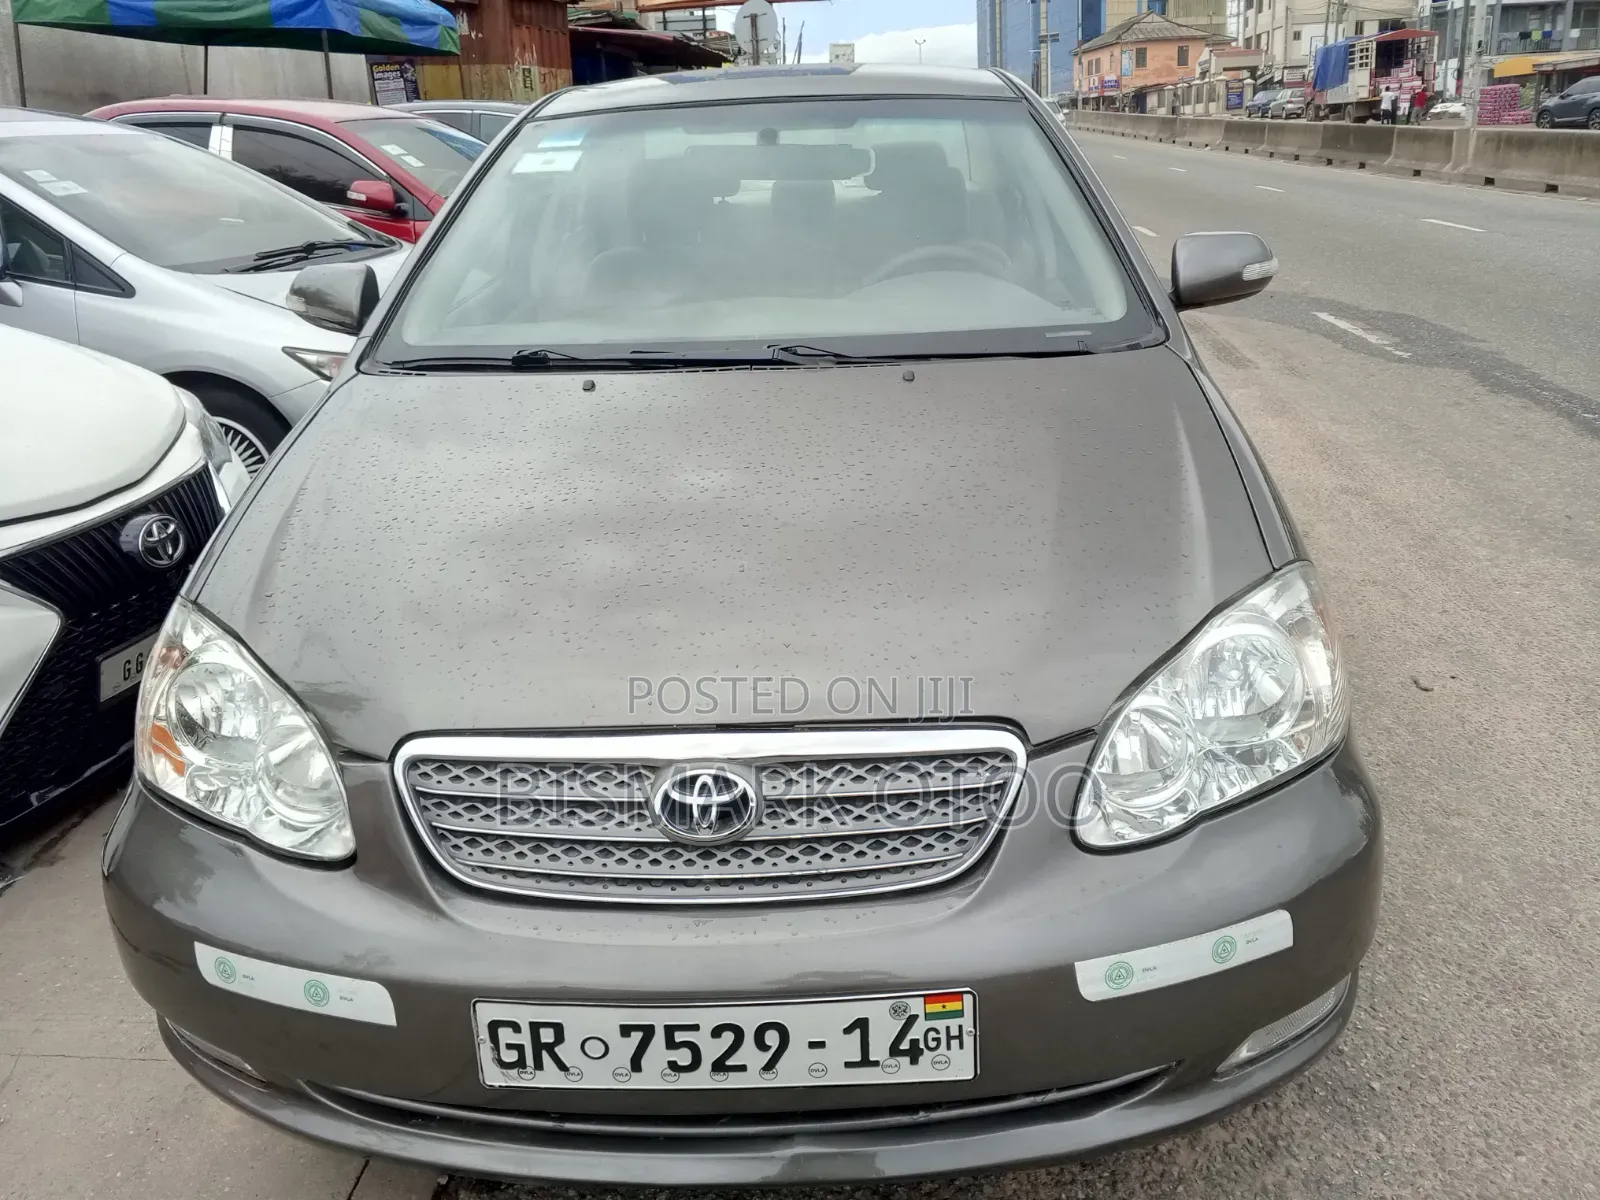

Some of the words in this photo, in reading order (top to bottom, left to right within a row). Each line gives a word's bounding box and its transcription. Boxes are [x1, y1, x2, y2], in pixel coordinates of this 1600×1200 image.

[373, 64, 400, 72] Golden
[487, 1019, 570, 1072] GR
[619, 1021, 790, 1073] 7529
[924, 1024, 964, 1051] GH
